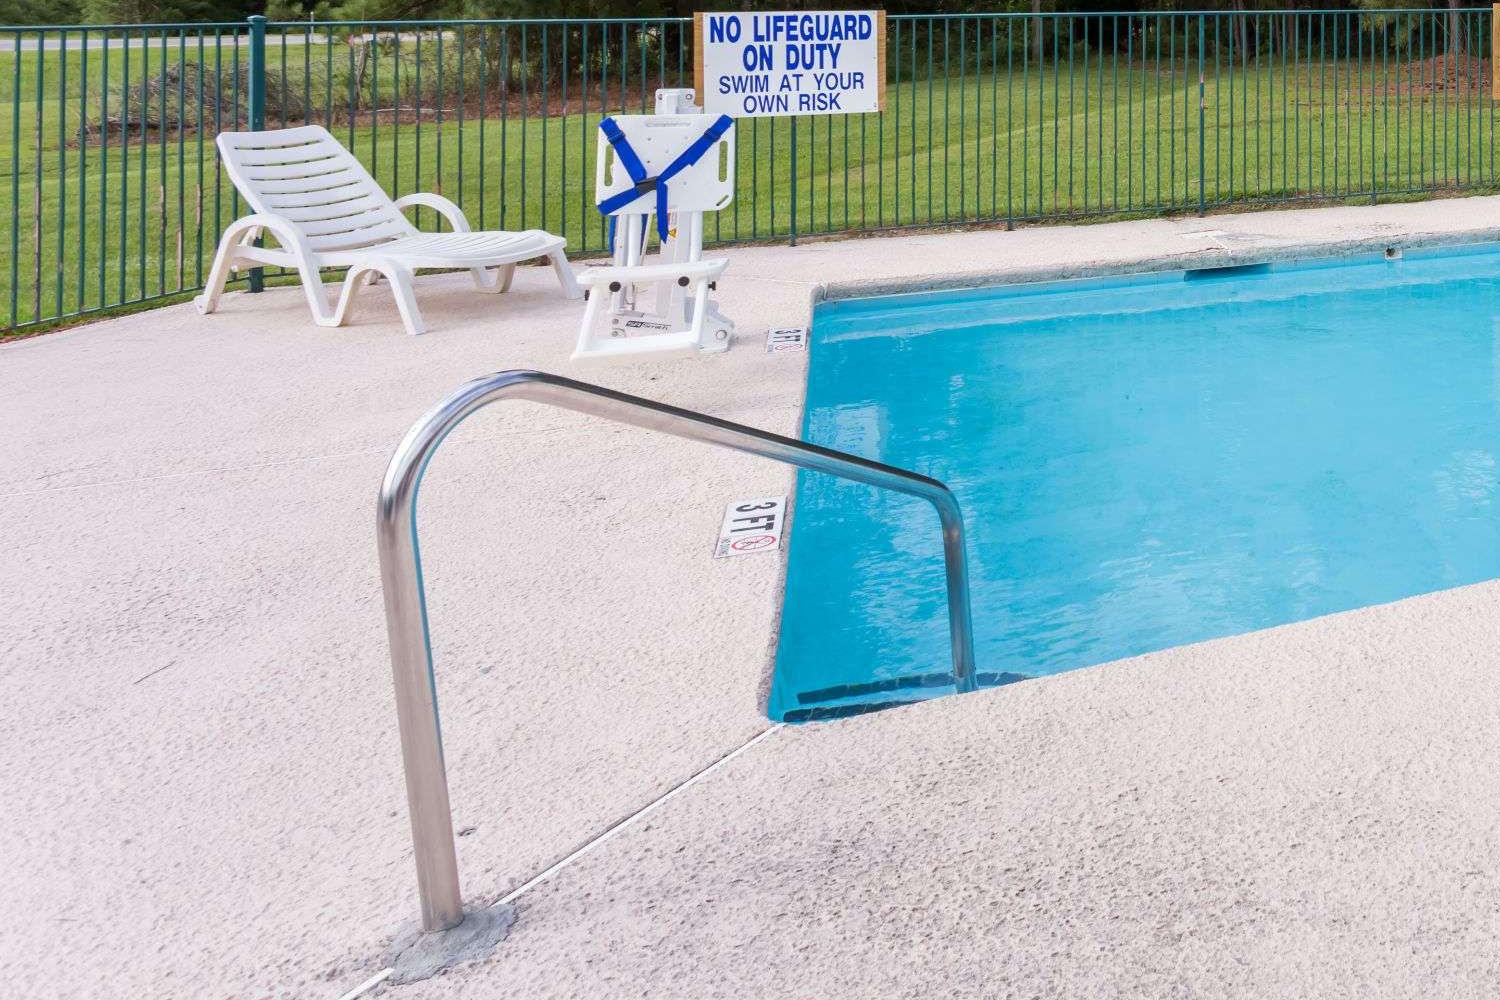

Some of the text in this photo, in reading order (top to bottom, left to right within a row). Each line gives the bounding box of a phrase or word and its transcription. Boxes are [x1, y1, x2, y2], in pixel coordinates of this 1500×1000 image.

[709, 14, 872, 43] NO LIFEGUARD
[742, 43, 841, 72] ON DUTY
[719, 72, 865, 94] SWIM AT YOUR
[743, 93, 841, 114] OWN RISK
